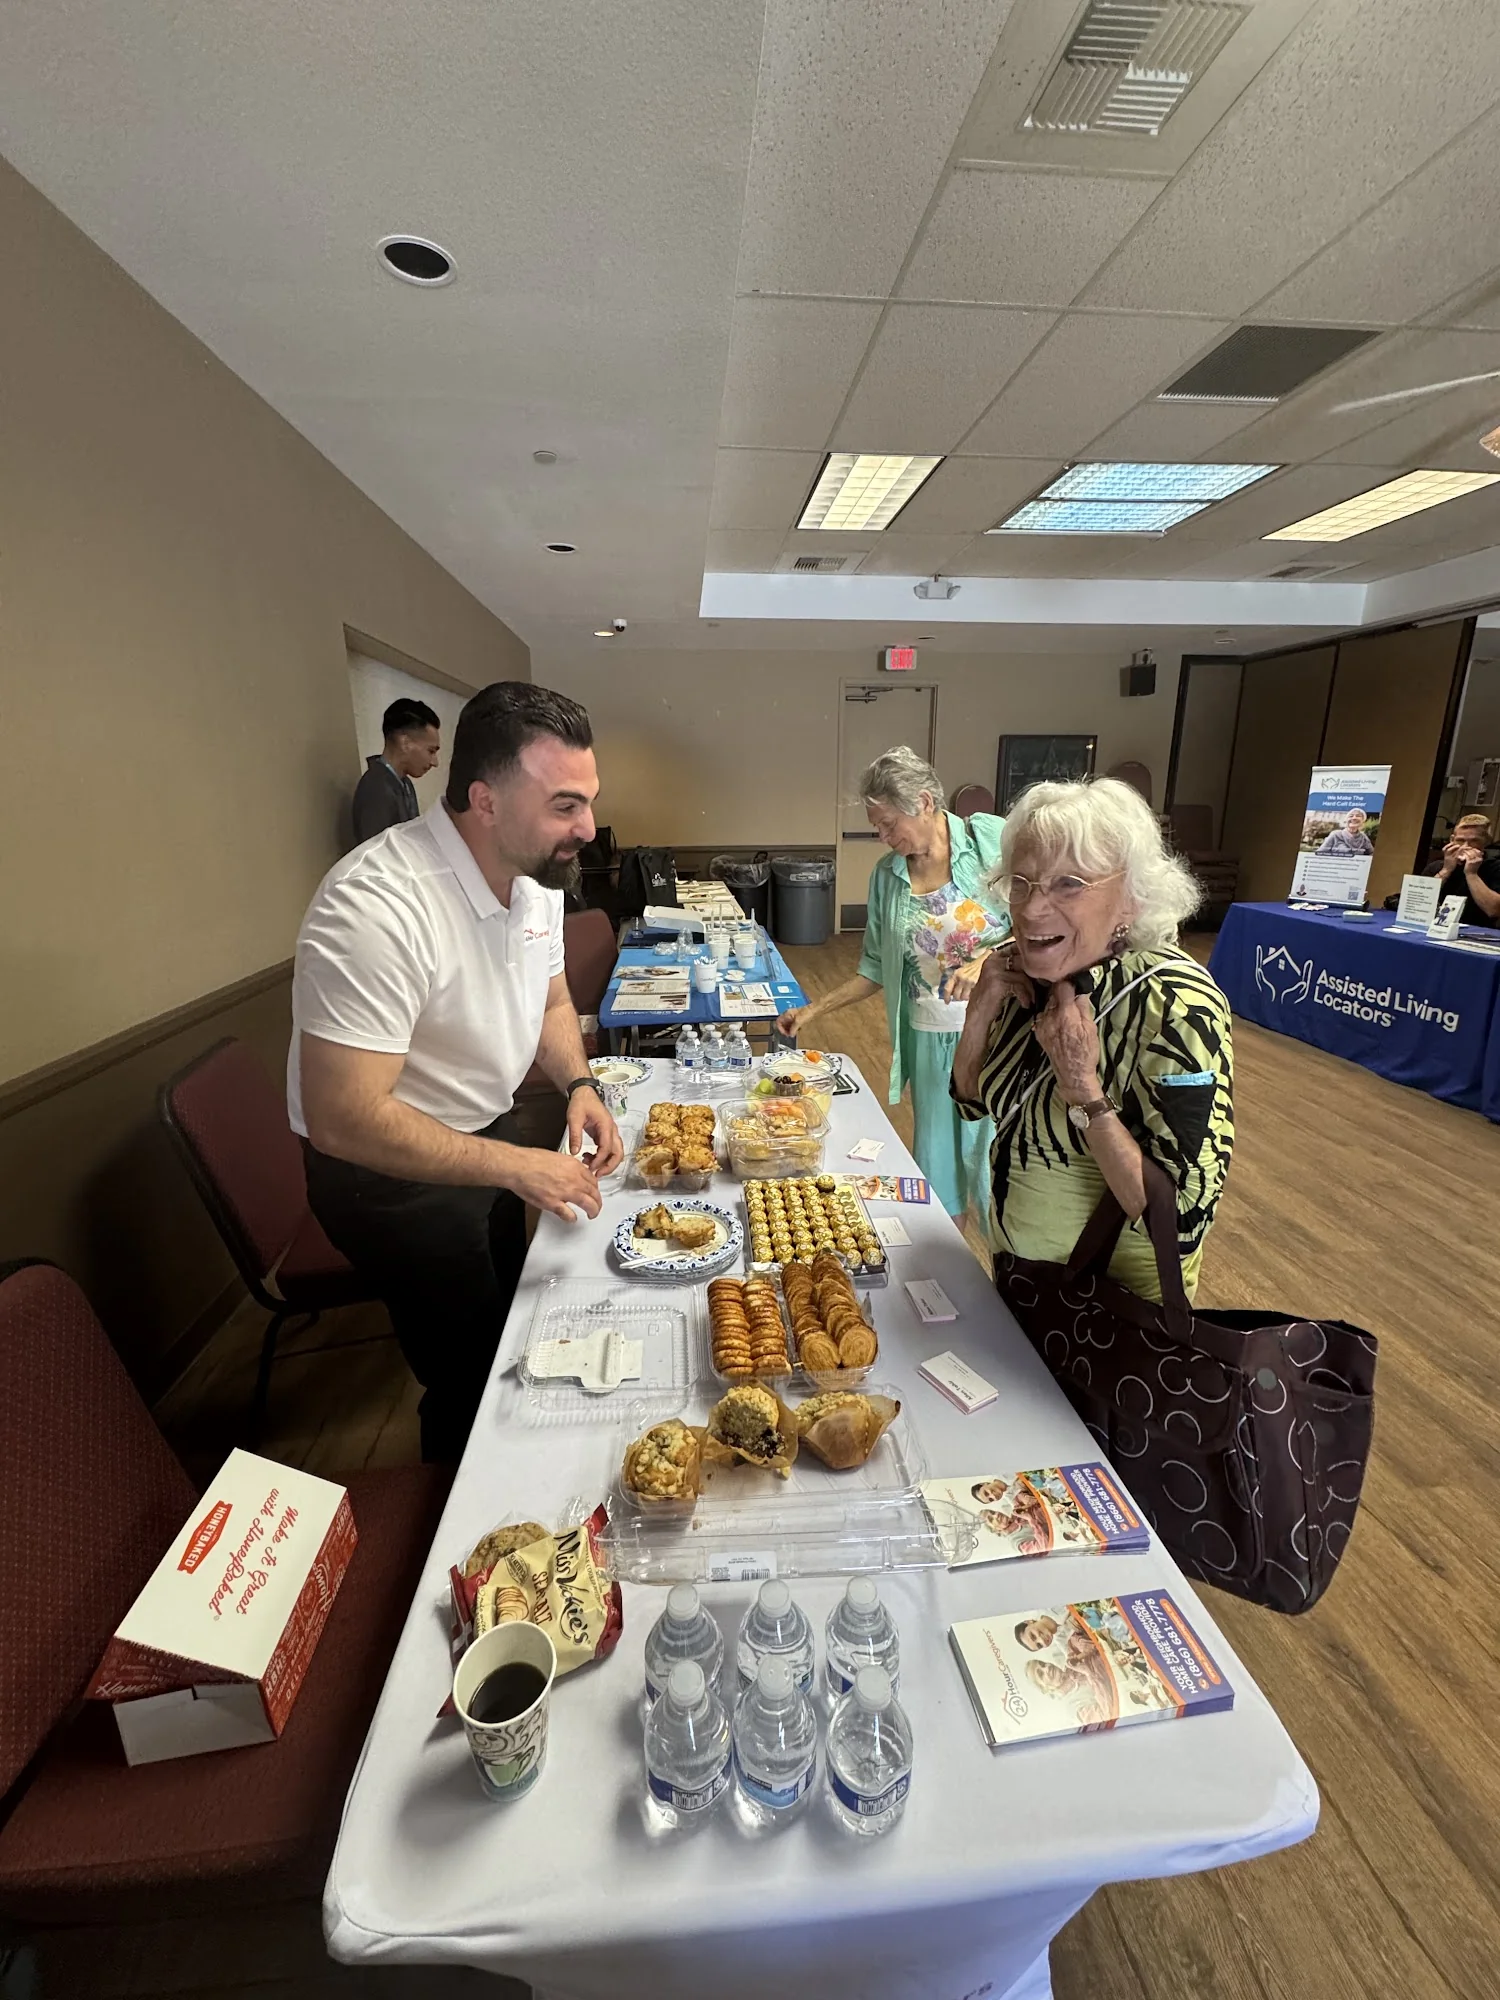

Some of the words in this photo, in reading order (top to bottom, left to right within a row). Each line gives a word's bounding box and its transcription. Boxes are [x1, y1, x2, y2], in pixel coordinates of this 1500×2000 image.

[1313, 985, 1393, 1028] Locators
[1316, 968, 1391, 1007] Assisted
[1394, 992, 1460, 1033] Living
[259, 1487, 280, 1516] with
[1083, 1468, 1109, 1500] 681-7778
[271, 1506, 299, 1546] Make
[1106, 1502, 1124, 1522] (866)
[185, 1506, 227, 1568] HONEYBAKED
[554, 1530, 580, 1575] Miss
[208, 1516, 265, 1616] HoneyBaked
[260, 1547, 278, 1568] It
[236, 1569, 269, 1615] Great
[554, 1571, 590, 1645] Vickie's
[1131, 1604, 1171, 1663] NEIGHBORHOOD
[1134, 1599, 1164, 1639] PROVIDER
[1145, 1598, 1182, 1645] 681-7778
[1160, 1640, 1180, 1664] CARE
[1178, 1647, 1203, 1678] (866)
[1169, 1666, 1188, 1690] YOUR
[1176, 1665, 1198, 1694] HOME
[1011, 1699, 1026, 1713] 24
